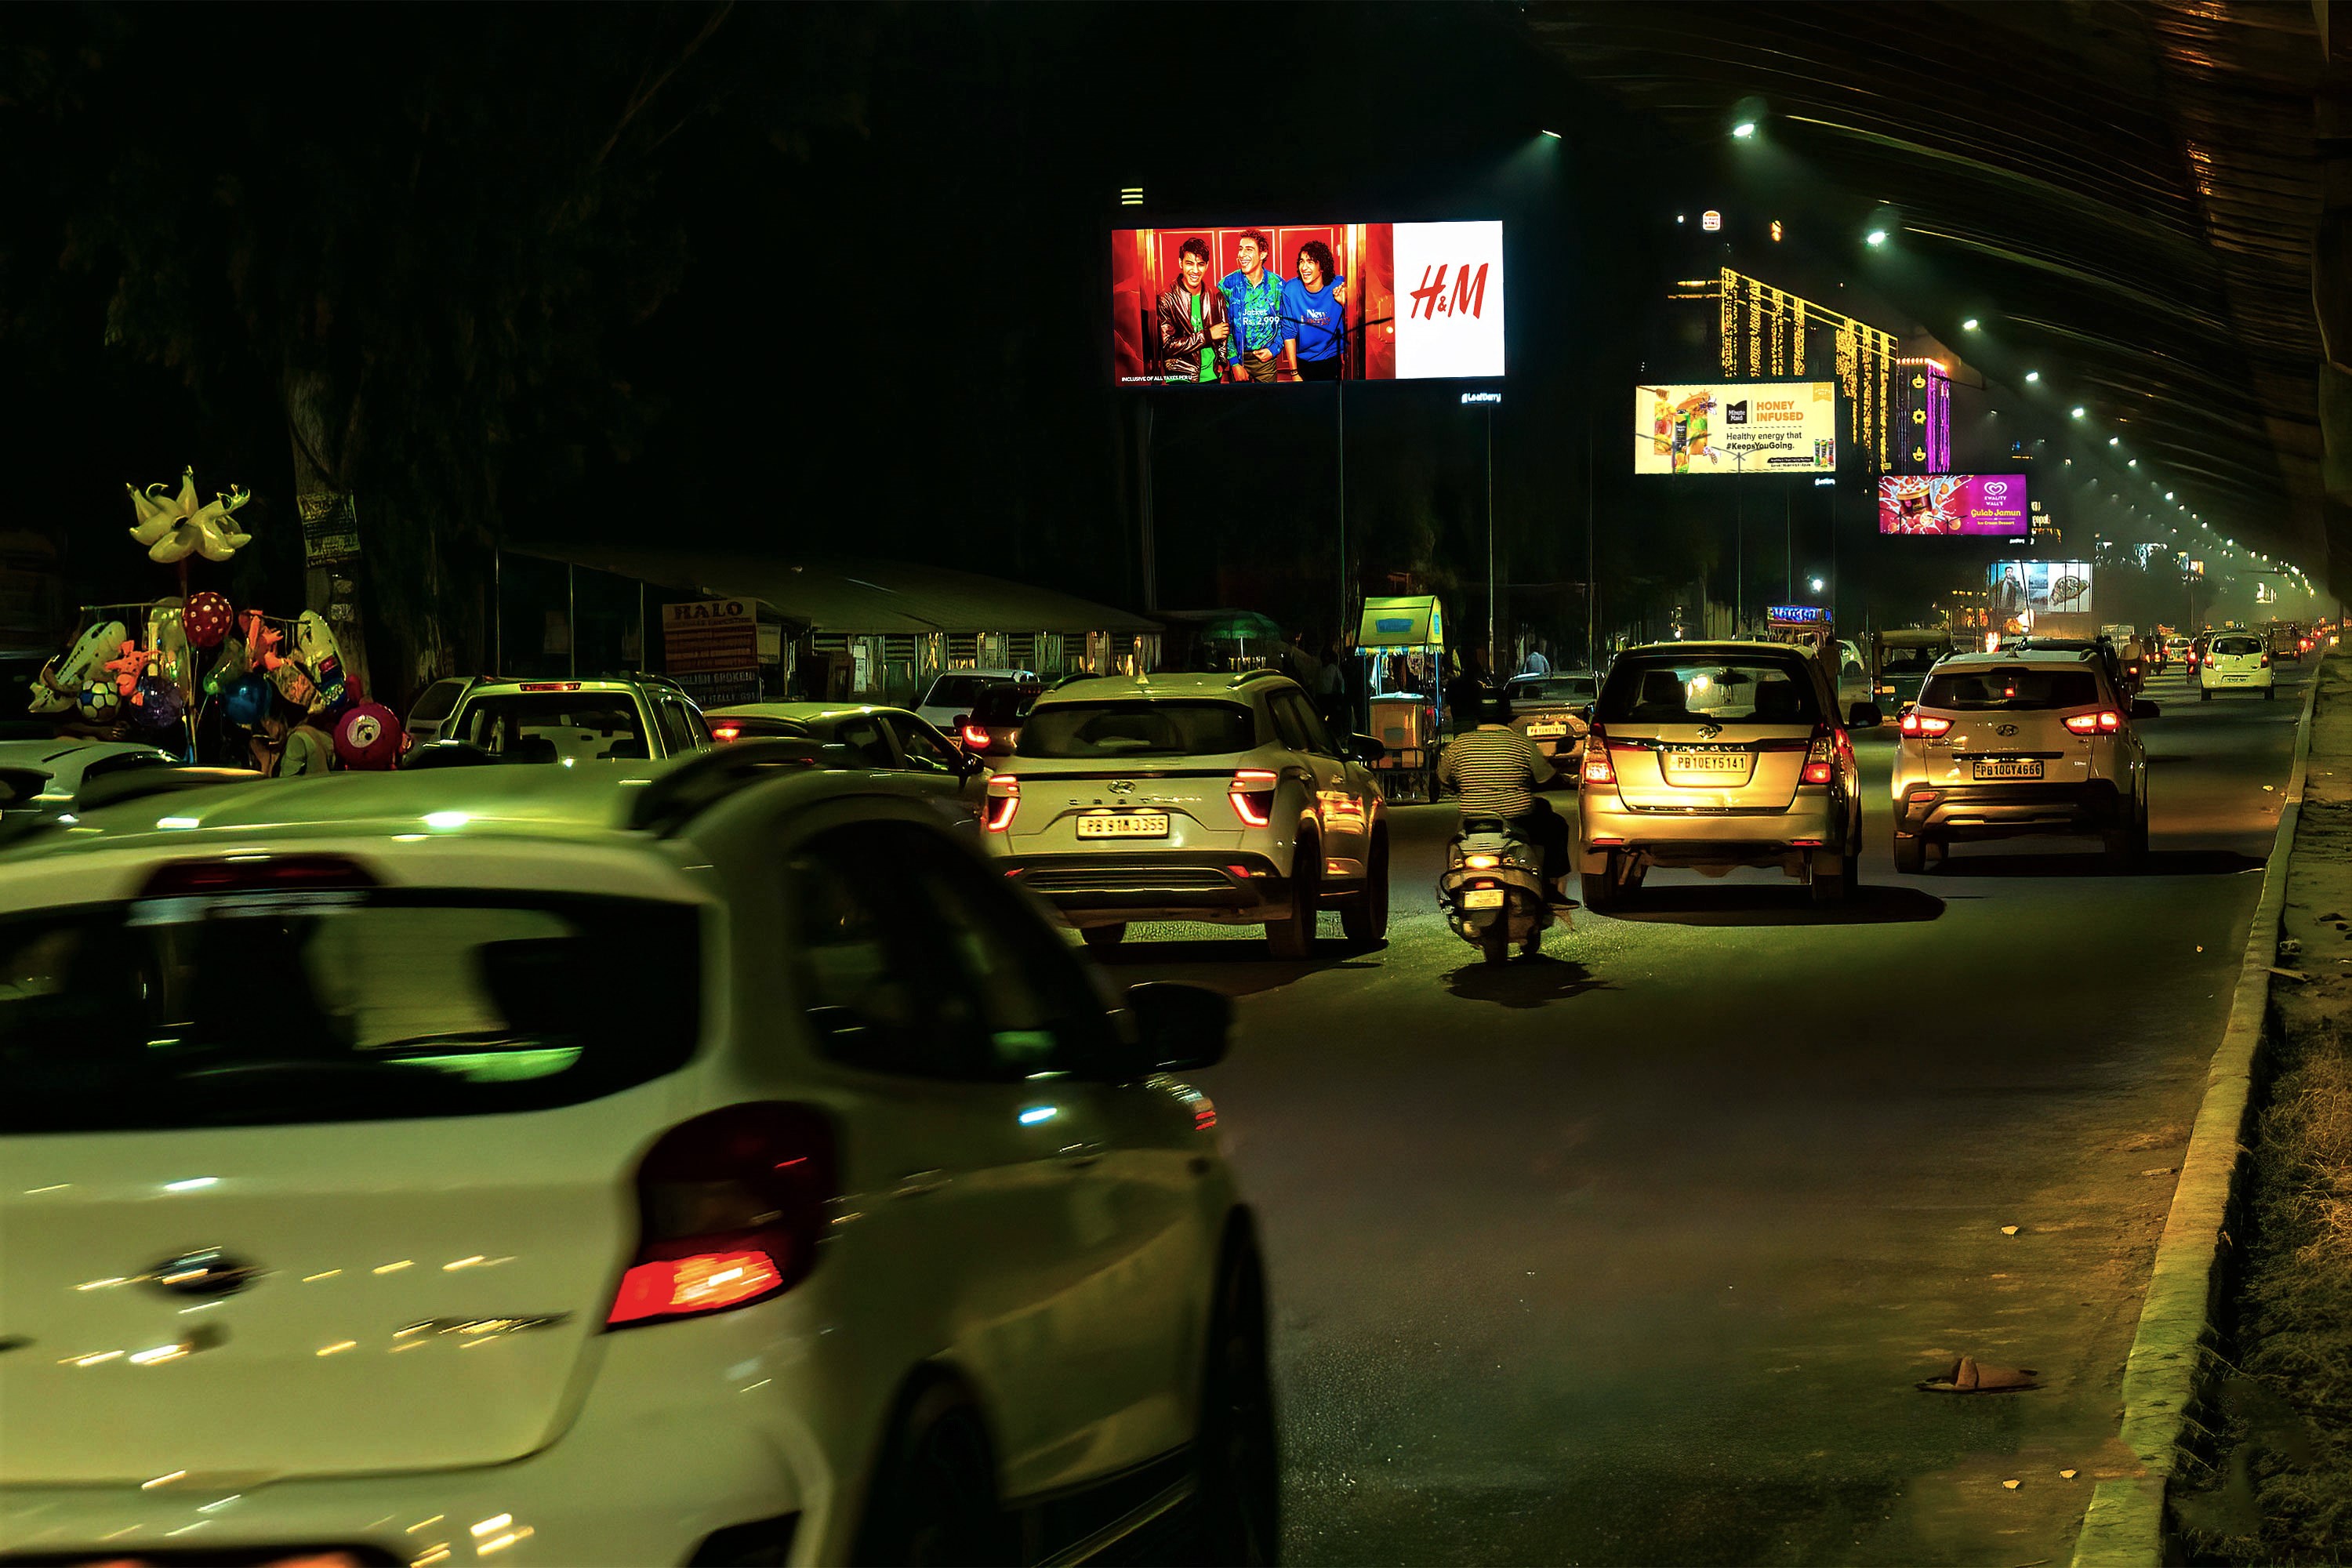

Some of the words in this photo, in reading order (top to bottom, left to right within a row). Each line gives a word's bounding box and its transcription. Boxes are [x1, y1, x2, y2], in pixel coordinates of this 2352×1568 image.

[1410, 263, 1489, 320] H&M
[1306, 309, 1327, 318] New
[1243, 317, 1255, 325] Rs.
[1257, 316, 1280, 326] 2,999
[1756, 401, 1795, 411] HONEY
[1756, 412, 1804, 422] INFUSED
[1726, 441, 1795, 452] #KeepsYouGoing.
[1971, 509, 1994, 517] Gulab
[675, 601, 743, 619] HALO
[1678, 757, 1744, 769] PB10EY5141
